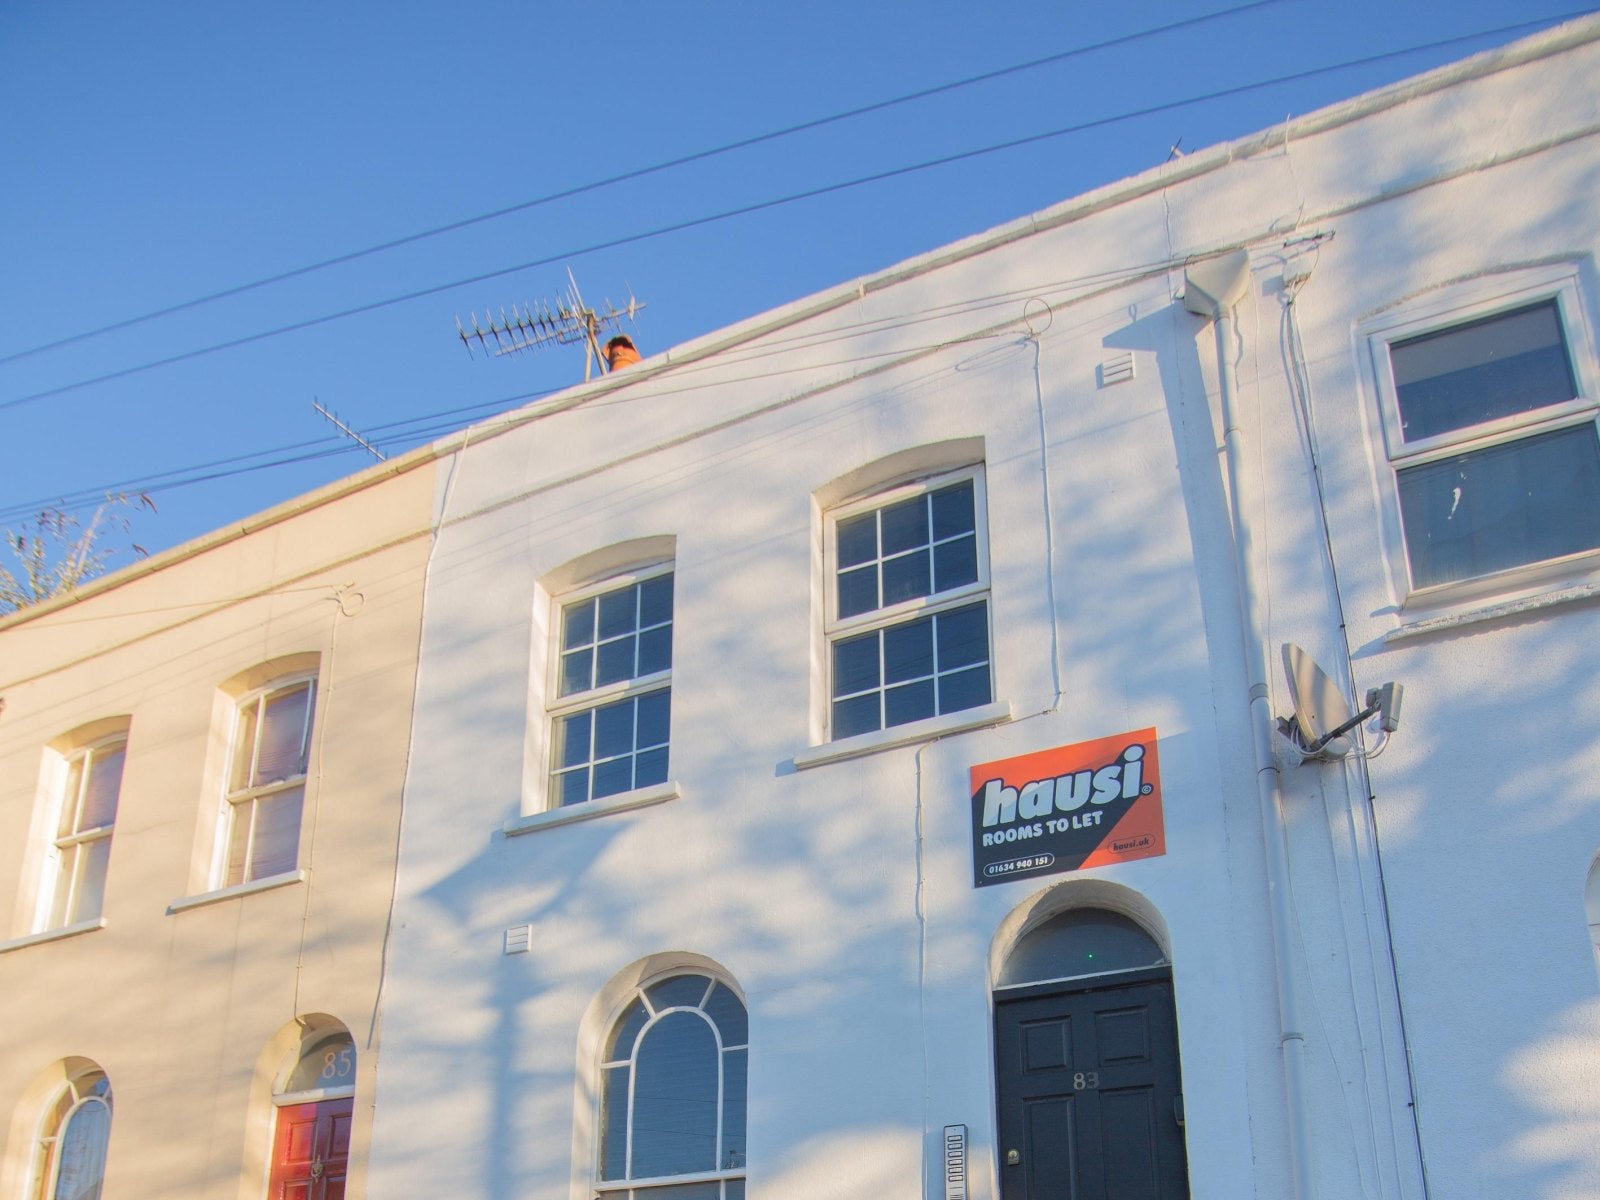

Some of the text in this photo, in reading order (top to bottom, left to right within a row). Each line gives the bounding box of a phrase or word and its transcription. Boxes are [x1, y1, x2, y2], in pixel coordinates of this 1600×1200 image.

[982, 745, 1144, 828] hausi
[982, 810, 1104, 847] ROOMS TO LET
[1113, 838, 1150, 851] hausi.uk
[988, 856, 1048, 875] 01634 940 151
[322, 1049, 352, 1079] 85
[1073, 1072, 1099, 1090] 83
